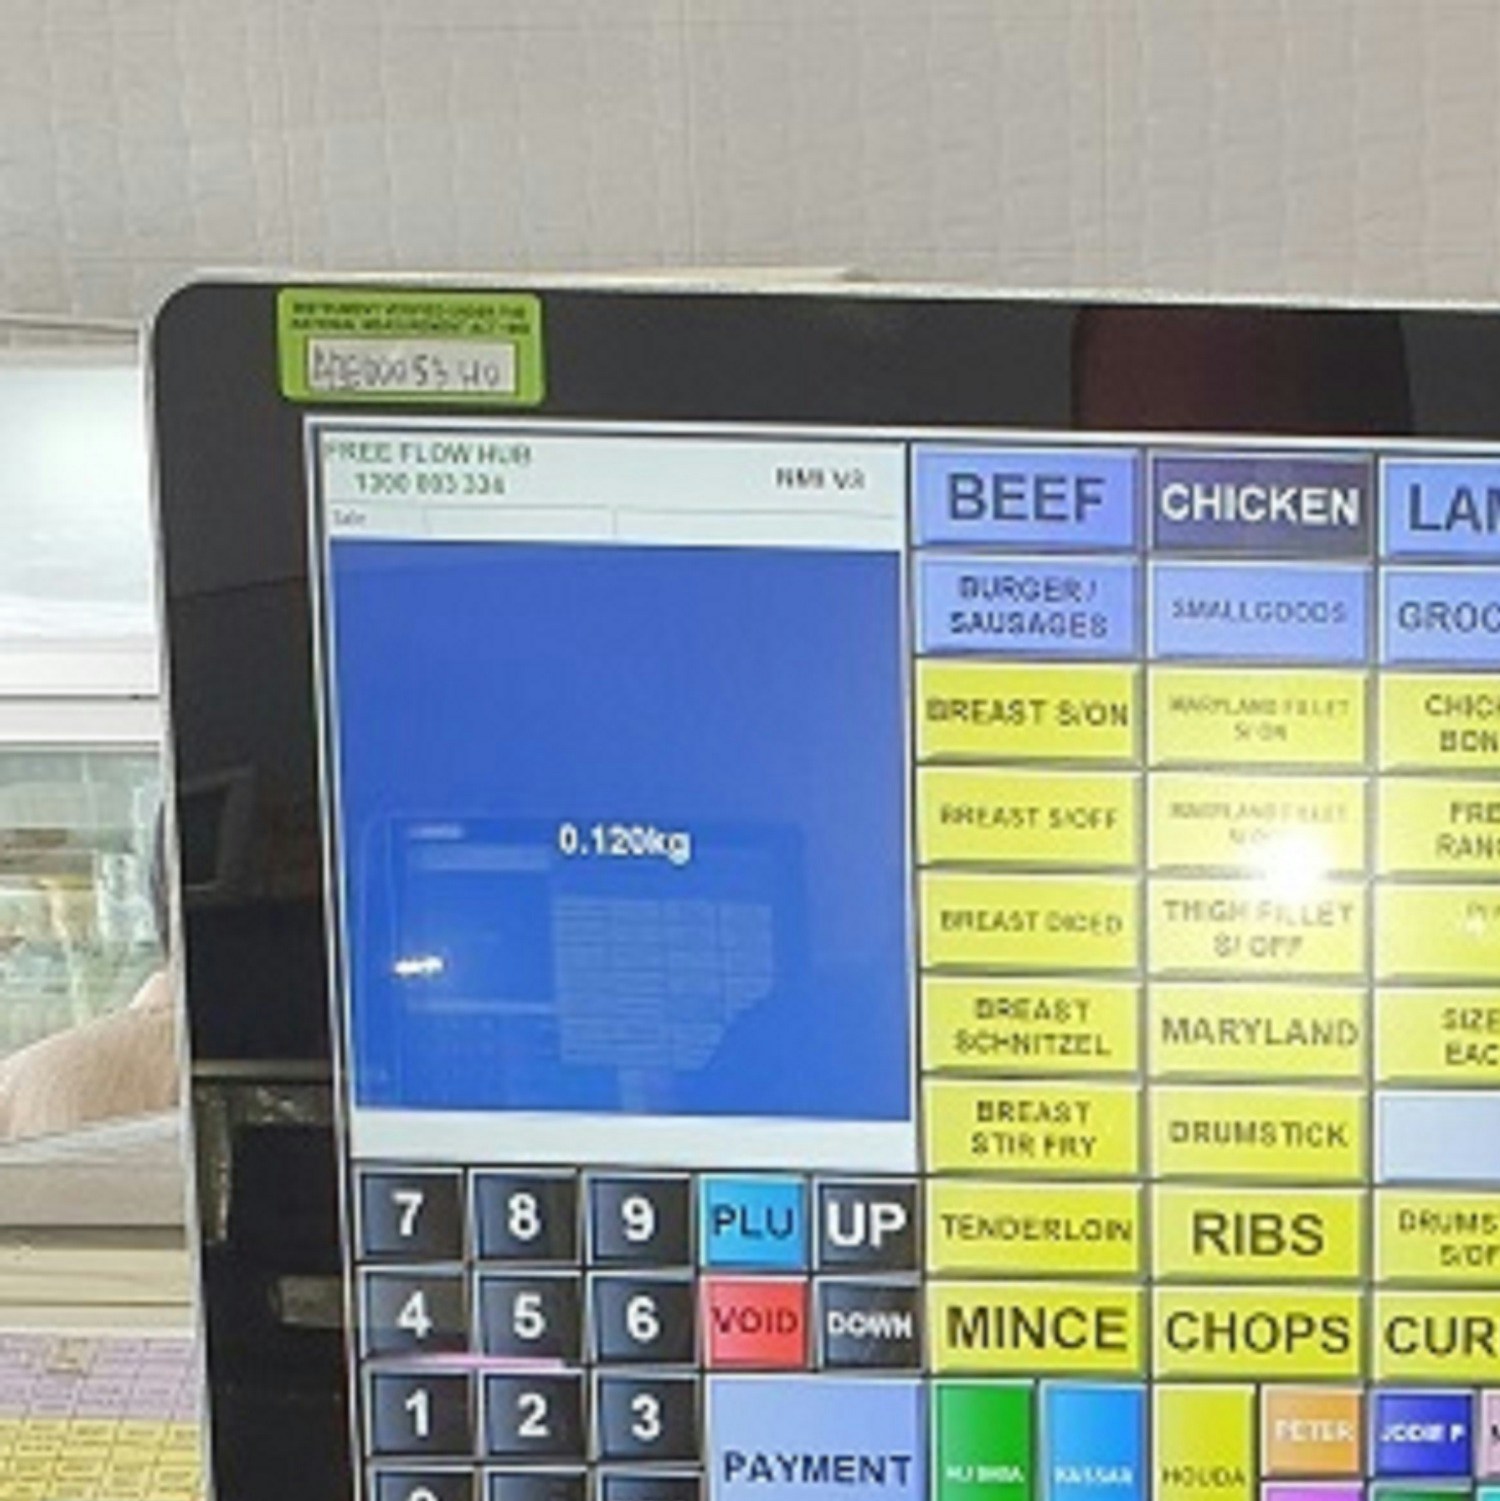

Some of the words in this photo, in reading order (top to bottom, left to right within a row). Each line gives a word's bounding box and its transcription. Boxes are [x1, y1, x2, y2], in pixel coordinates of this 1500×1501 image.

[325, 441, 392, 465] FREE
[399, 442, 470, 466] FLOW
[477, 444, 533, 466] HUB
[948, 473, 1106, 522] BEEF
[1160, 483, 1361, 526] CHICKEN
[949, 611, 1108, 639] SAUSAGES
[1172, 600, 1346, 624] SMALLGOODS
[926, 699, 1046, 725] BREAST
[939, 804, 1038, 829] BREAST
[558, 823, 692, 866] 0.120kg
[939, 908, 1039, 934] BREAST
[1046, 911, 1124, 938] DICED
[1163, 898, 1246, 923] THIGH
[975, 997, 1091, 1021] BREAST
[954, 1029, 1112, 1057] SCHNITZEL
[1160, 1017, 1361, 1048] MARYLAND
[976, 1100, 1091, 1123] BREAST
[970, 1131, 1036, 1156] STIR
[1043, 1133, 1098, 1158] FRY
[1168, 1120, 1349, 1149] DRUMSTICK
[393, 1191, 426, 1239] 7
[506, 1193, 542, 1240] 8
[620, 1194, 656, 1244] 9
[712, 1203, 795, 1240] PLU
[826, 1201, 908, 1248] UP
[940, 1213, 1133, 1243] TENDERLOIN
[1191, 1211, 1325, 1257] RIBS
[396, 1291, 433, 1339] 4
[511, 1294, 547, 1341] 5
[625, 1296, 661, 1342] 6
[711, 1307, 799, 1337] VOID
[826, 1310, 914, 1341] DOWN
[946, 1306, 1129, 1351] MINCE
[1165, 1311, 1351, 1356] CHOPS
[404, 1390, 431, 1437] 1
[517, 1393, 550, 1438] 2
[630, 1395, 663, 1440] 3
[1275, 1419, 1354, 1443] PETER
[1450, 1423, 1466, 1444] P
[722, 1451, 913, 1488] PAYMENT
[1160, 1466, 1247, 1489] HOUDA
